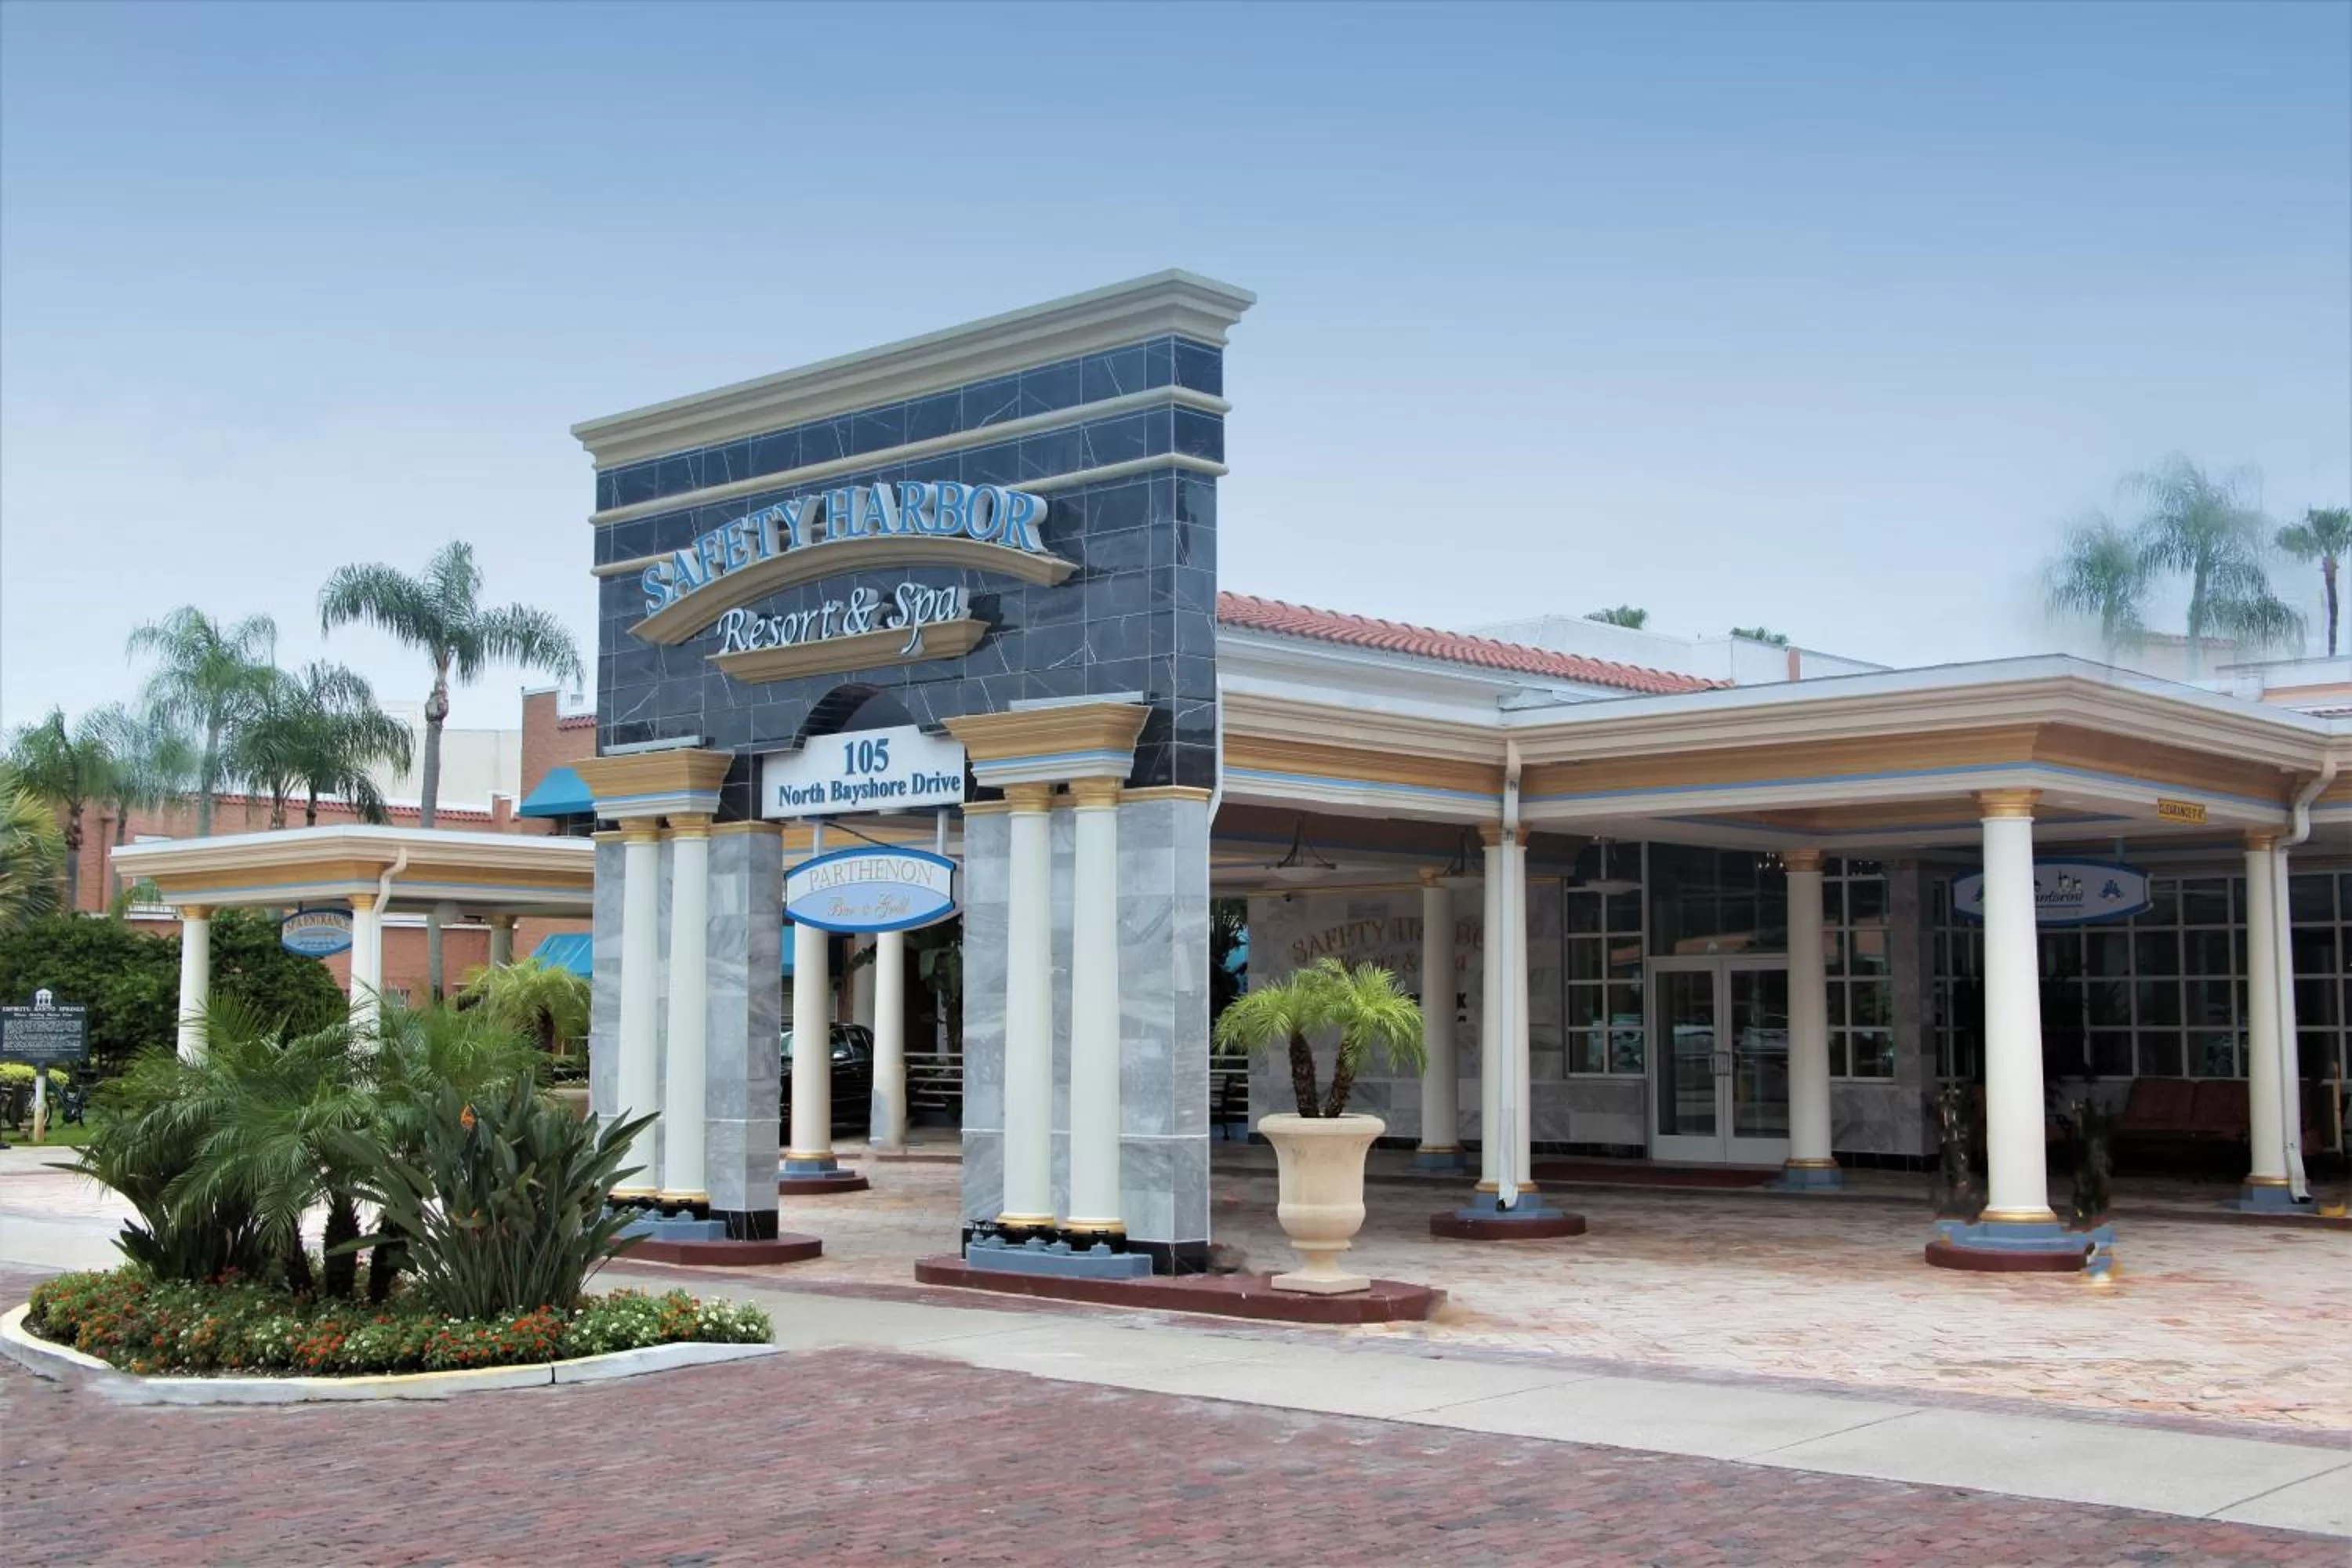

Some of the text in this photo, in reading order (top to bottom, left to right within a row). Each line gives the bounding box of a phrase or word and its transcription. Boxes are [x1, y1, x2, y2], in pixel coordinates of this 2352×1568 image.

[641, 480, 1054, 616] SAFETY HARBOR
[717, 582, 966, 657] Resort & Spa
[844, 738, 890, 776] 105
[778, 771, 961, 808] North Bayshore Drive
[807, 858, 935, 891] PARTHENON
[1292, 920, 1385, 966] SAFETY
